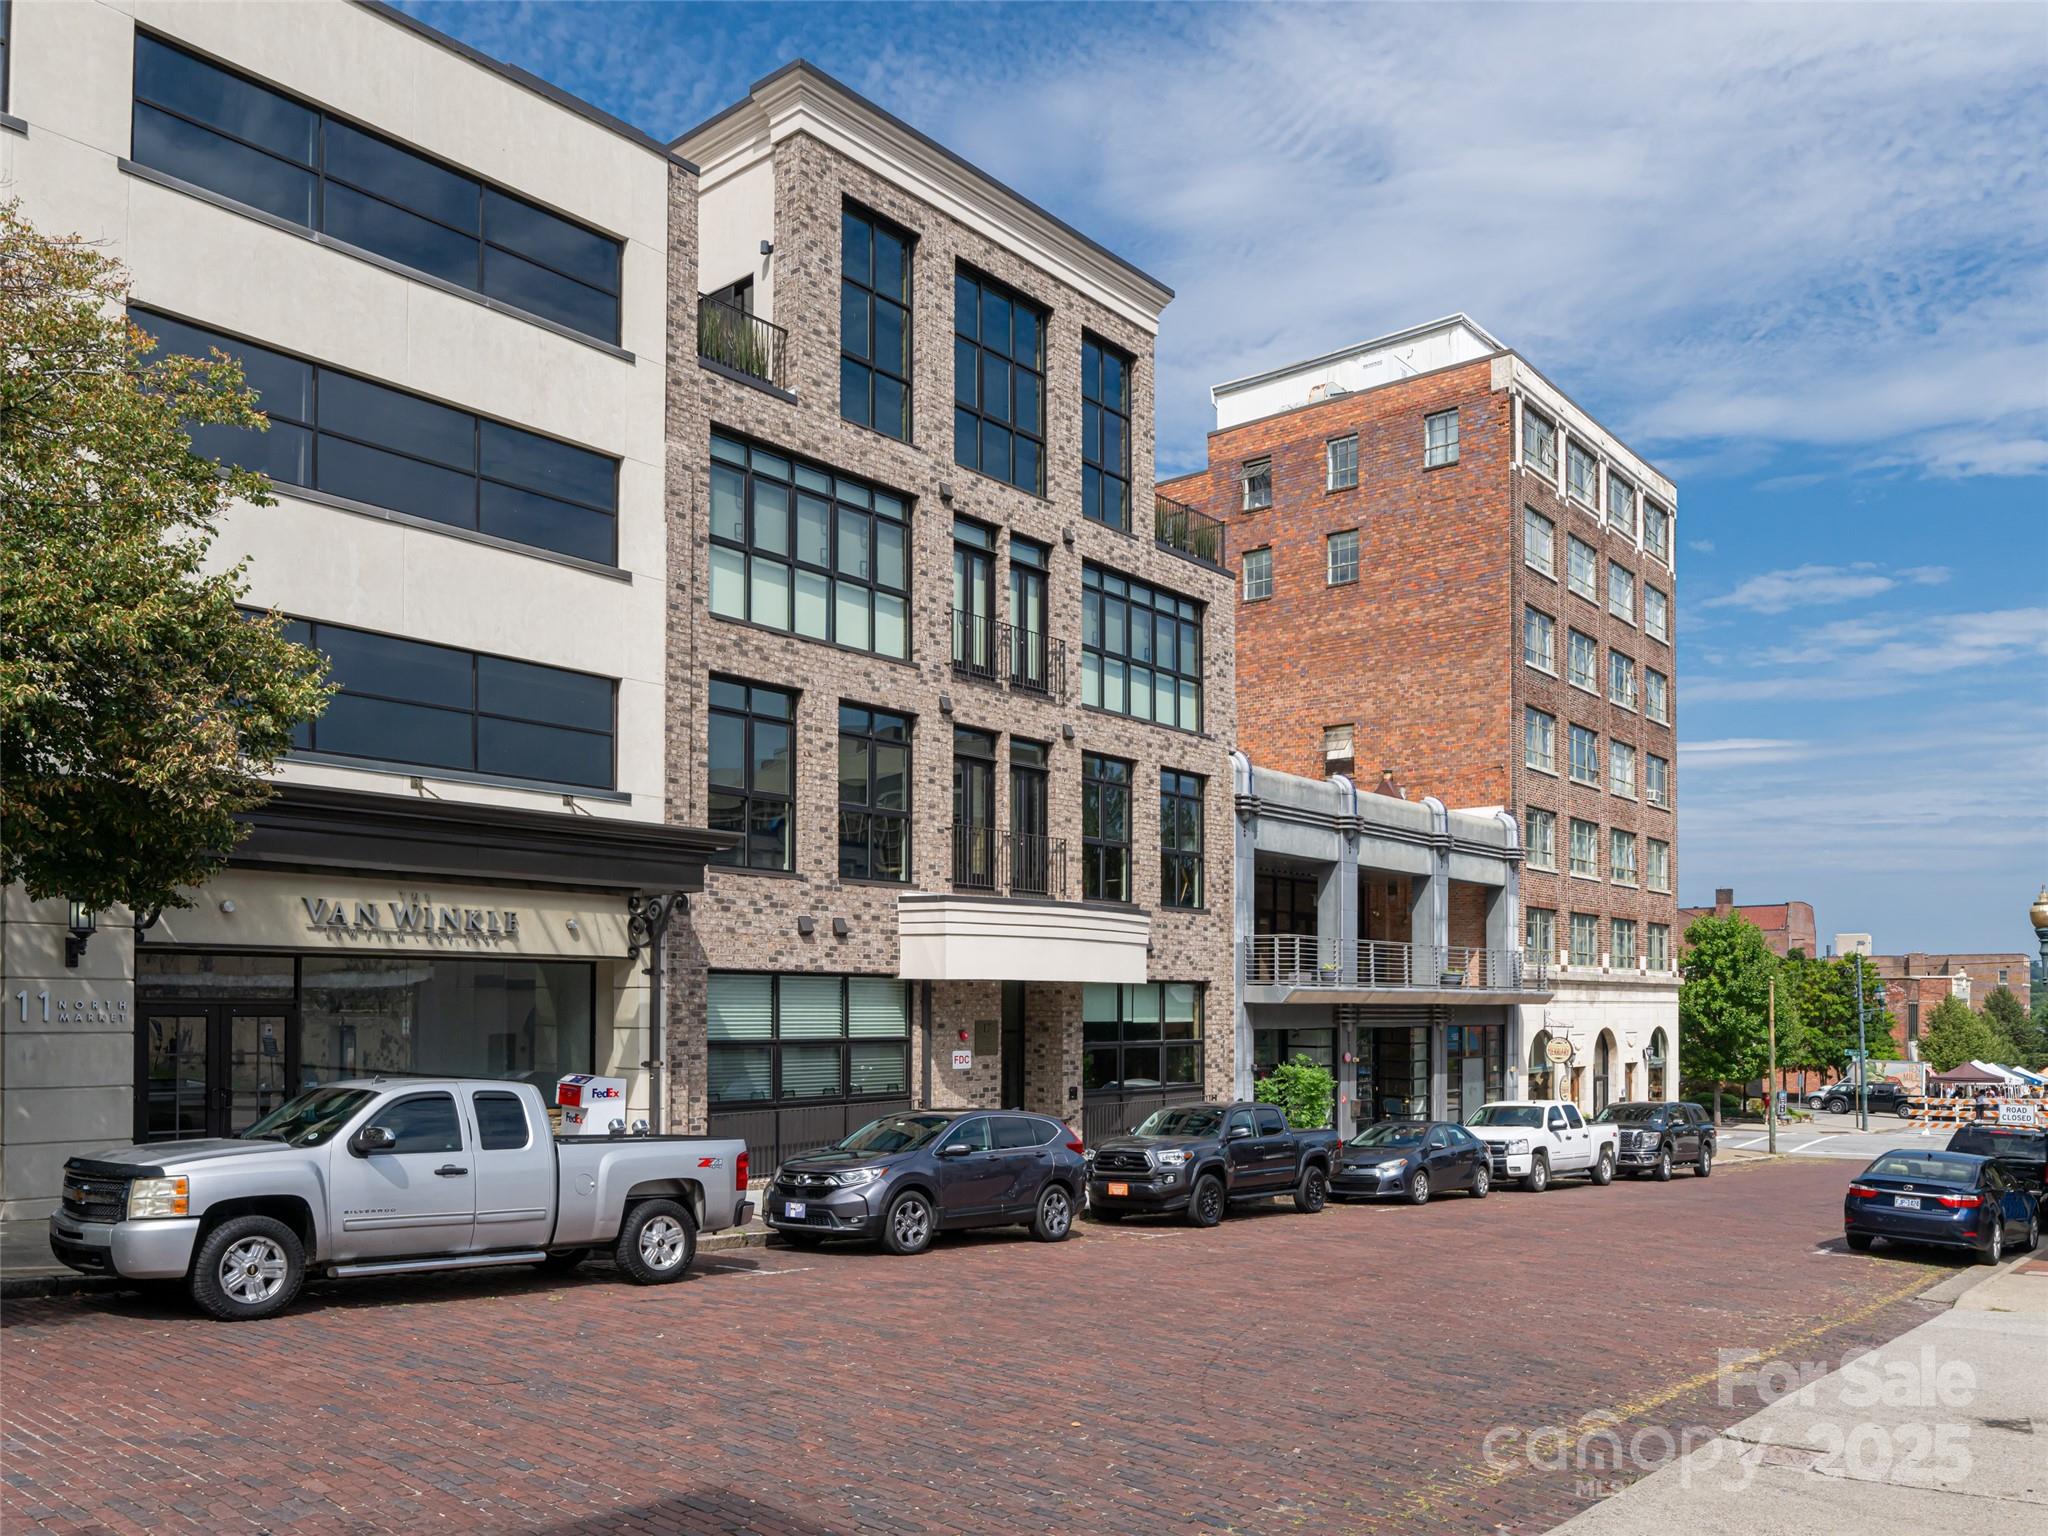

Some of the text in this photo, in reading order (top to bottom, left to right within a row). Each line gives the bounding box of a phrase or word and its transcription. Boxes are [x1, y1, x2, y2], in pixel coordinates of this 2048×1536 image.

[301, 897, 518, 934] VAN WINKLE
[15, 990, 50, 1023] 11
[58, 1000, 128, 1011] NORTH
[58, 1012, 128, 1023] MARKET
[954, 1055, 970, 1065] FDC
[592, 1087, 620, 1099] FedEx
[2006, 1106, 2028, 1114] ROAD
[565, 1111, 583, 1125] FedEx
[2001, 1113, 2032, 1122] CLOSED
